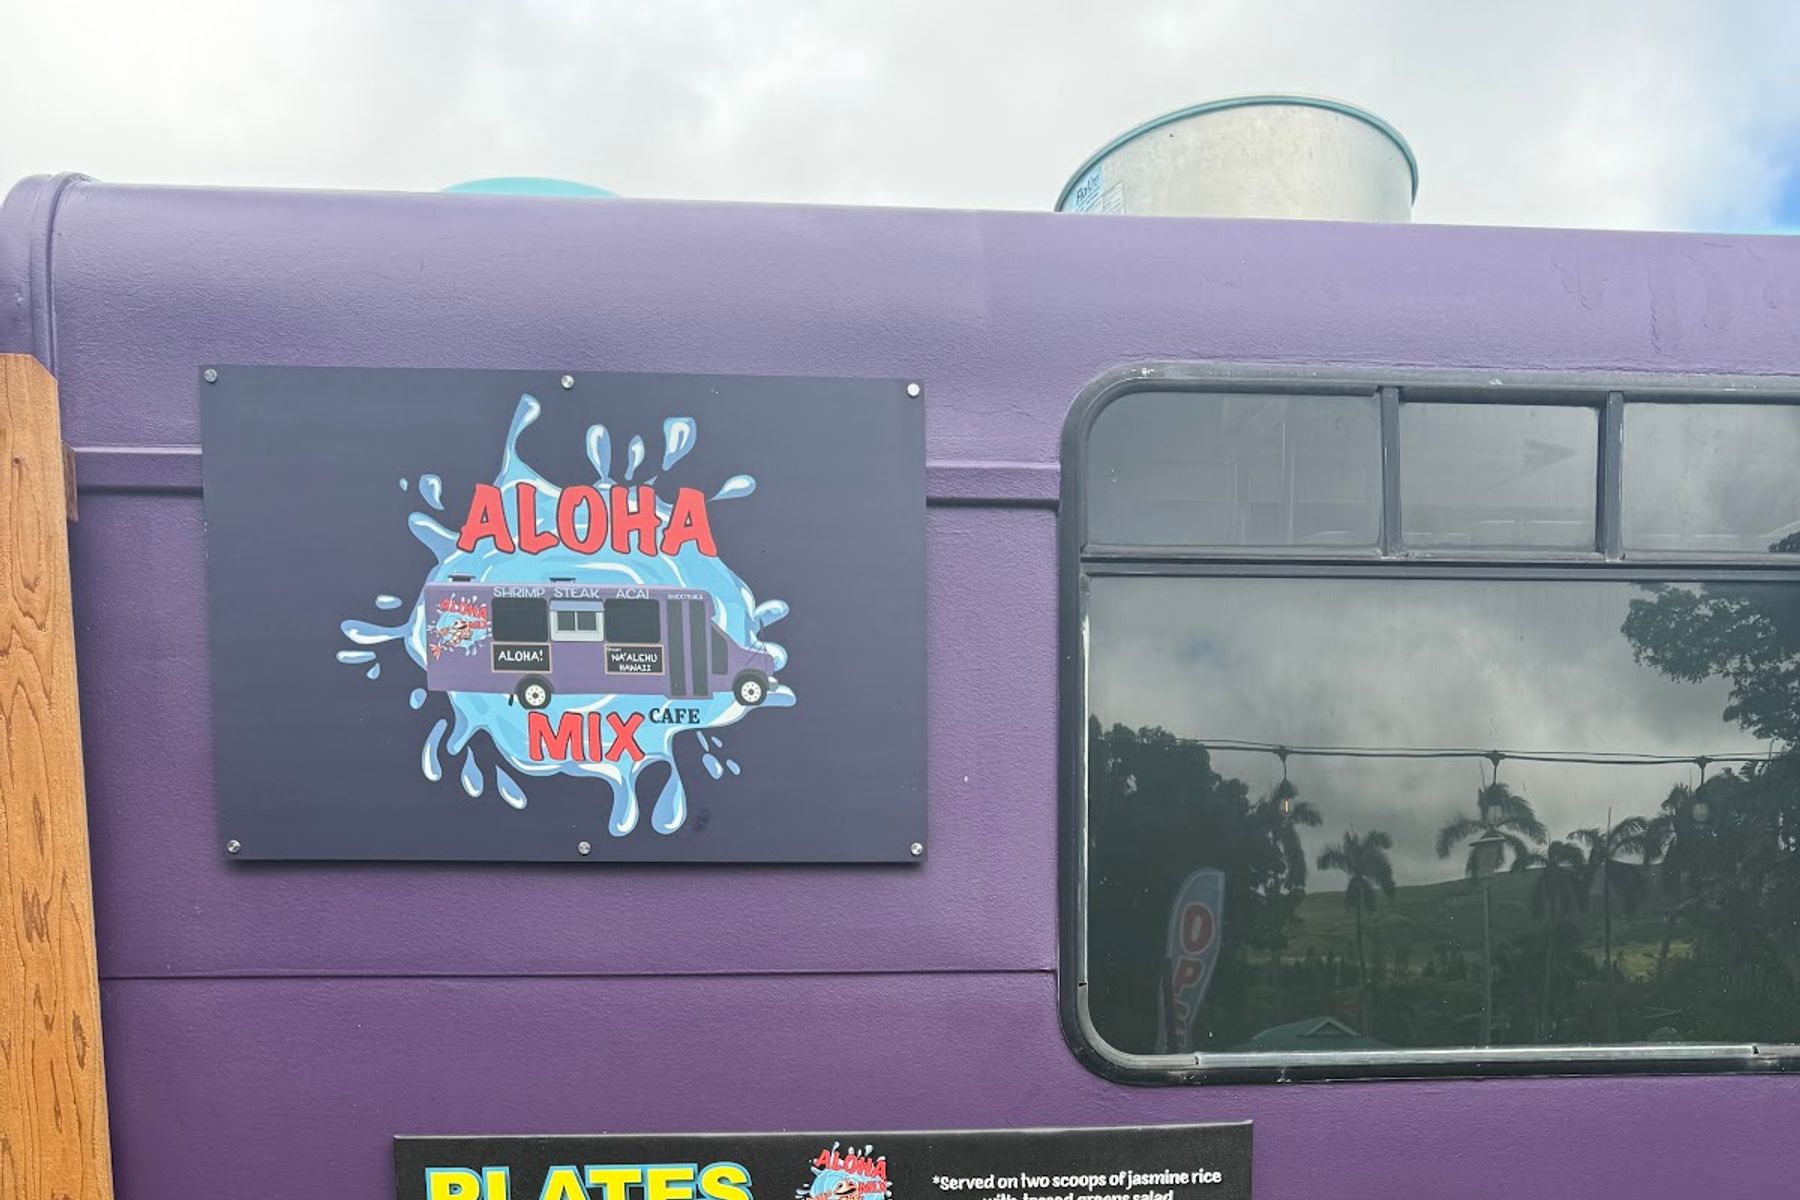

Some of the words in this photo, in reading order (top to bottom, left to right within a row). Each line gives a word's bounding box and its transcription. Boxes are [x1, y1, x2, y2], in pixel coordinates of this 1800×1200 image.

[456, 482, 717, 557] ALOHA
[493, 586, 546, 598] SHRIMP
[553, 587, 600, 599] STEAK
[616, 588, 650, 600] ACAI
[498, 649, 543, 662] ALOHA!
[619, 664, 652, 672] HAWAII
[527, 711, 646, 762] MIX
[648, 707, 701, 725] CAFE
[816, 1148, 886, 1180] ALOHA
[997, 1176, 1018, 1189] on
[1020, 1173, 1050, 1189] two
[1052, 1175, 1107, 1192] scoops
[1109, 1171, 1127, 1187] of
[1126, 1169, 1189, 1190] jasmine
[1190, 1169, 1222, 1184] rice
